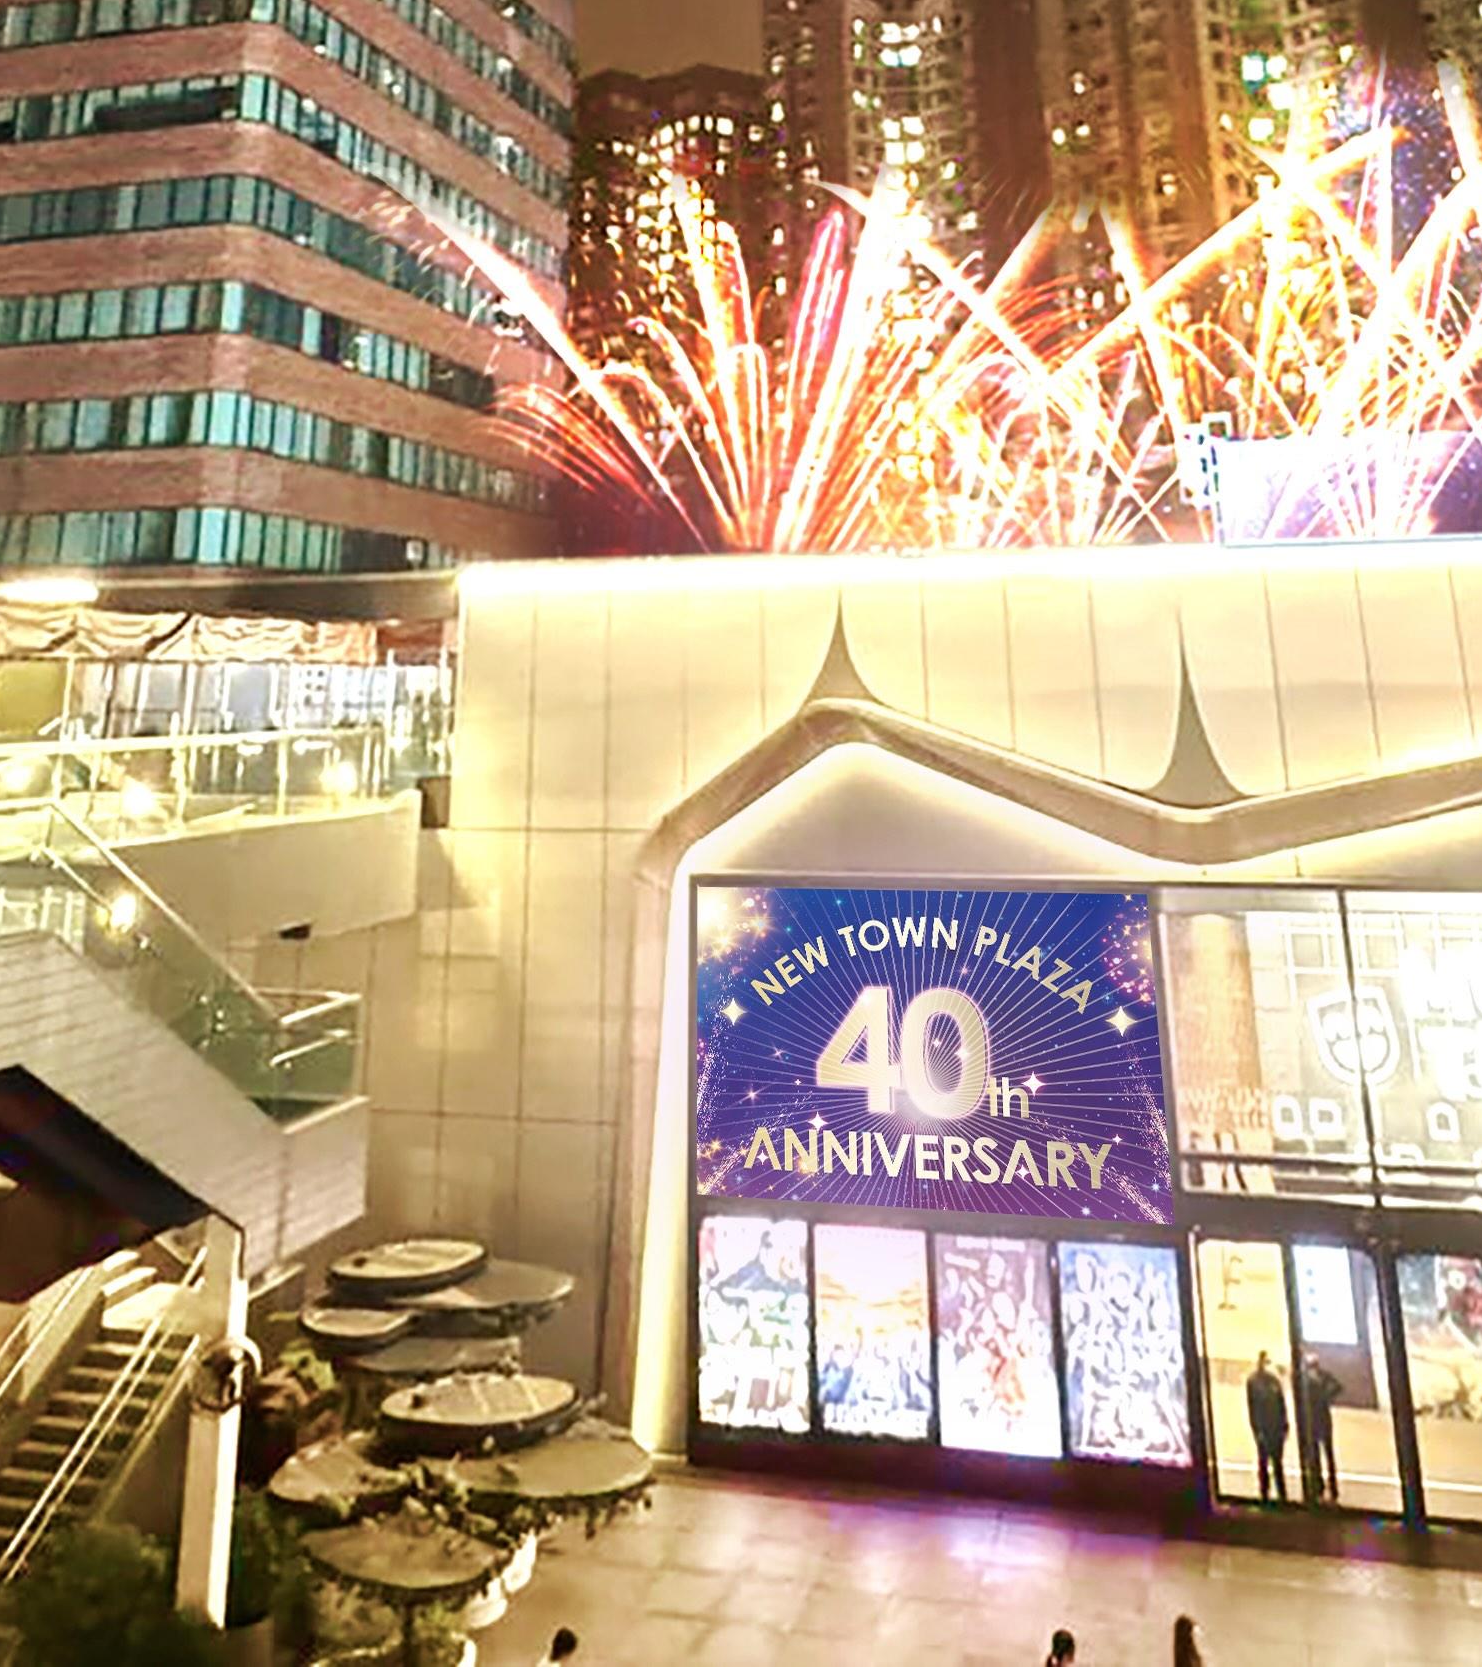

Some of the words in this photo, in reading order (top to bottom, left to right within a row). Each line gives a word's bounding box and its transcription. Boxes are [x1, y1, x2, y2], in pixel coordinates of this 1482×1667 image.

[750, 936, 829, 1006] NEW
[837, 916, 959, 958] TOWN
[974, 925, 1095, 1014] PLAZA
[744, 1126, 1112, 1190] ANNIVERSARY
